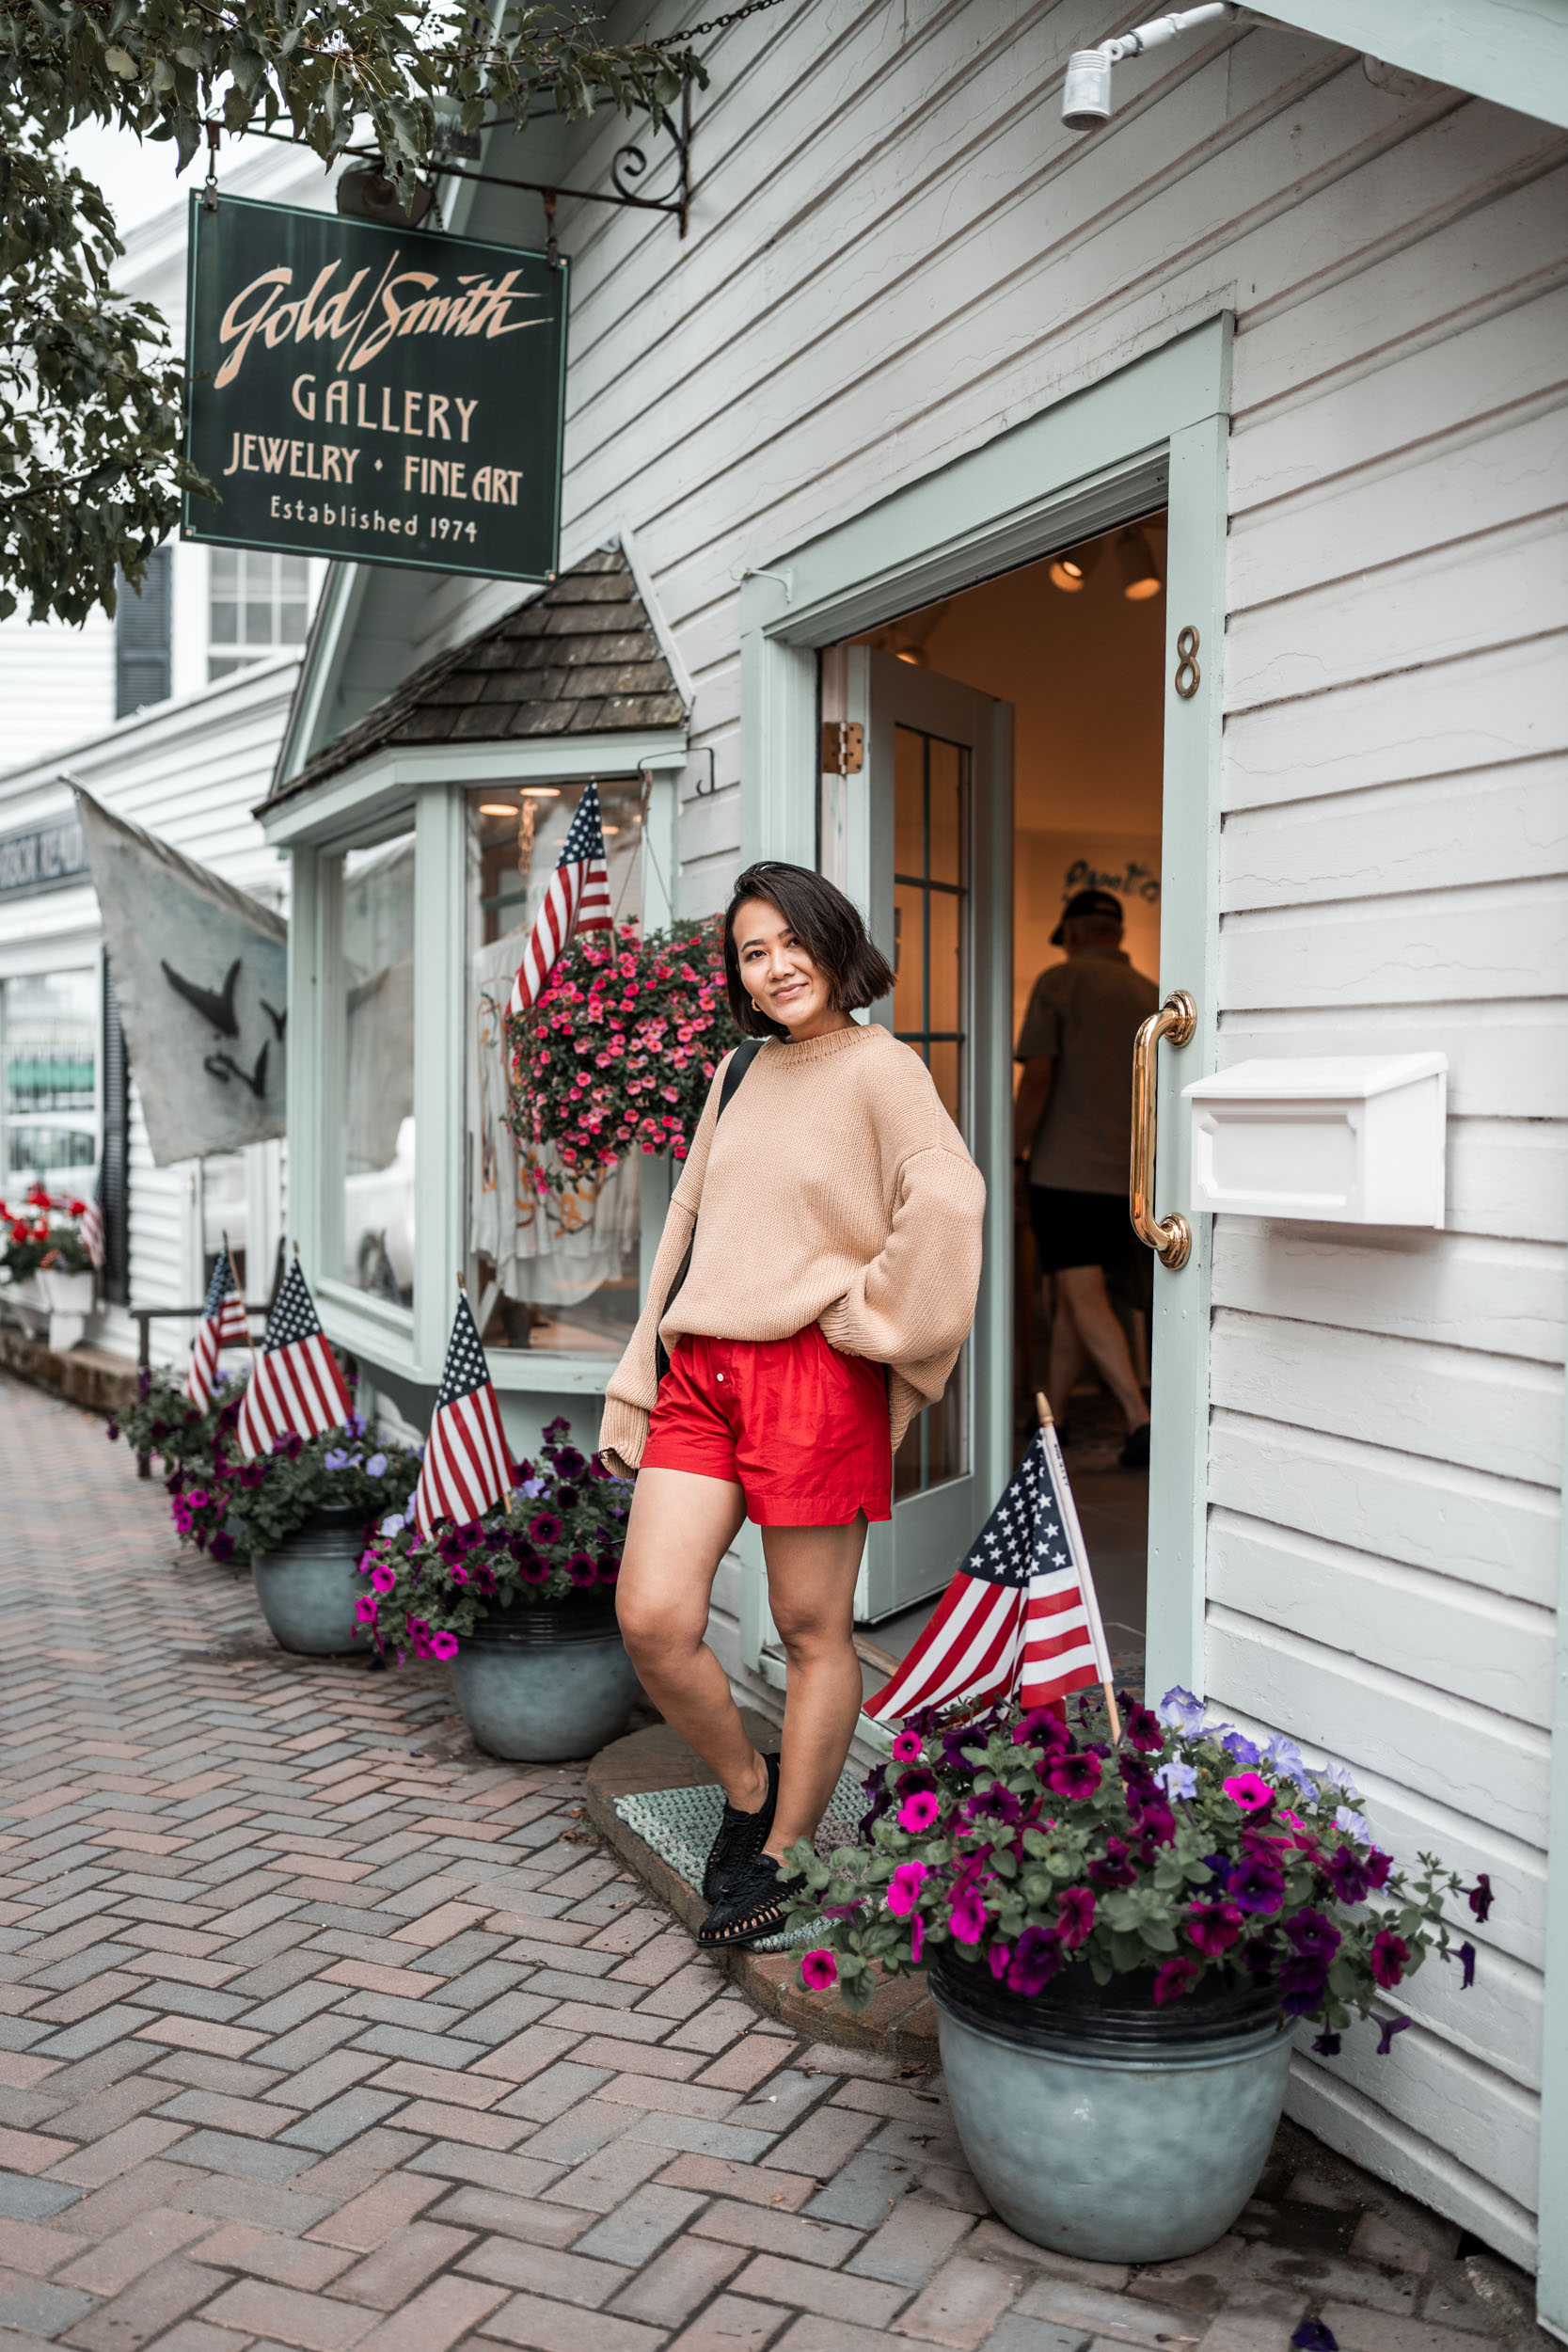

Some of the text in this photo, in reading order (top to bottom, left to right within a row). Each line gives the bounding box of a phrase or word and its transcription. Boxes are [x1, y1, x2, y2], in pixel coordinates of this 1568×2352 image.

[293, 374, 479, 443] GALLERY
[223, 432, 524, 506] JEWELRY FINE ART
[270, 495, 478, 543] Established 1974
[1175, 625, 1200, 698] 8
